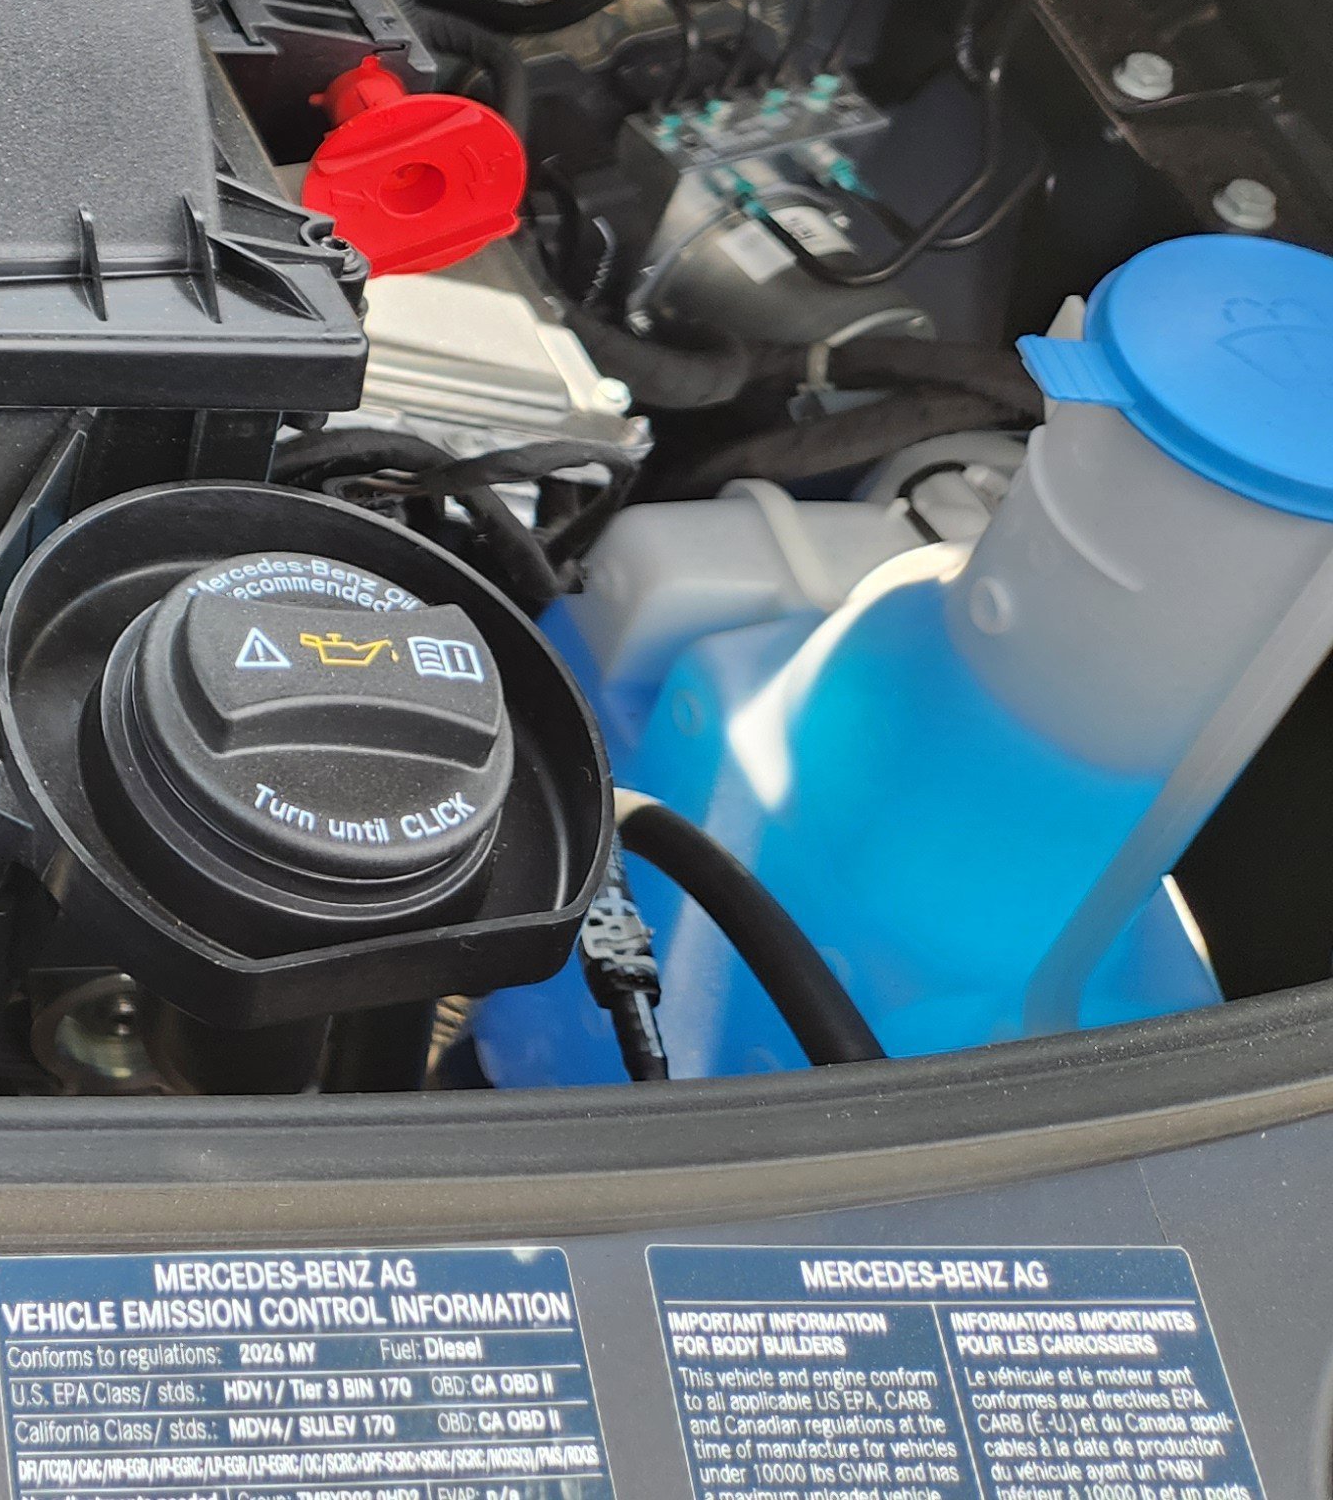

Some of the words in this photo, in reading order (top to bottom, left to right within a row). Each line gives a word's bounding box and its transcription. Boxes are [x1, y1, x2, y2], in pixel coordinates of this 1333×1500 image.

[186, 558, 378, 596] Mercedes-Benz
[384, 587, 421, 611] Oil
[225, 576, 394, 612] ecommended
[255, 783, 316, 832] Turn
[328, 816, 390, 845] until
[399, 791, 478, 841] CLICK
[153, 1258, 374, 1292] MERCEDES-BENZ
[376, 1257, 417, 1287] AG
[798, 1260, 1009, 1288] MERCEDES-BENZ
[1007, 1260, 1050, 1288] AG
[1, 1301, 117, 1333] VEHICLE
[121, 1297, 253, 1330] EMISSION
[257, 1294, 387, 1327] CONTROL
[389, 1290, 571, 1323] INFORMATION
[666, 1312, 768, 1331] IMPORTANT
[767, 1312, 888, 1331] INFORMATION
[948, 1312, 1078, 1331] INFORMATIONS
[1077, 1312, 1198, 1331] IMPORTANTES
[6, 1345, 93, 1370] Conforms
[96, 1345, 115, 1367] to
[118, 1342, 223, 1371] regulations:
[238, 1340, 285, 1364] 2026
[287, 1339, 317, 1362] MY
[379, 1337, 421, 1360] Fuel:
[423, 1335, 483, 1358] Diesel
[671, 1336, 710, 1355] FOR
[710, 1336, 762, 1355] BODY
[760, 1336, 848, 1355] BUILDERS
[955, 1335, 1006, 1355] POUR
[1005, 1335, 1040, 1355] LES
[1039, 1335, 1159, 1355] CARROSSIERS
[677, 1367, 714, 1386] This
[715, 1367, 774, 1386] vehicle
[775, 1367, 810, 1386] and
[809, 1367, 868, 1390] engine
[867, 1367, 938, 1386] conform
[963, 1366, 987, 1386] Le
[986, 1366, 1056, 1386] véhicule
[1055, 1366, 1077, 1386] et
[1076, 1366, 1095, 1386] le
[1094, 1366, 1156, 1386] moteur
[1155, 1366, 1195, 1386] sont
[10, 1383, 49, 1406] U.S.
[52, 1382, 89, 1405] EPA
[92, 1380, 153, 1410] Class/
[157, 1380, 207, 1403] stds.:
[222, 1379, 287, 1407] HDV1/
[288, 1377, 324, 1399] Tier
[326, 1376, 339, 1398] 3
[341, 1375, 374, 1398] BIN
[379, 1374, 412, 1396] 170
[430, 1373, 471, 1395] OBD:
[469, 1372, 498, 1394] CA
[498, 1371, 539, 1393] OBD
[541, 1370, 554, 1392] II
[969, 1389, 1058, 1409] conformes
[1057, 1389, 1090, 1409] aux
[1089, 1389, 1172, 1409] directives
[1170, 1389, 1208, 1409] EPA
[682, 1391, 703, 1410] to
[704, 1391, 726, 1410] all
[727, 1391, 814, 1414] applicable
[813, 1391, 841, 1410] US
[841, 1391, 883, 1413] EPA,
[882, 1391, 933, 1410] CARB
[14, 1419, 100, 1444] California
[103, 1417, 164, 1447] Class/
[168, 1418, 218, 1441] stds.:
[228, 1415, 296, 1444] MDV4/
[298, 1414, 358, 1437] SULEV
[362, 1412, 396, 1435] 170
[436, 1410, 477, 1433] OBD:
[476, 1409, 505, 1431] CA
[505, 1408, 546, 1430] OBD
[548, 1408, 561, 1429] II
[688, 1416, 721, 1434] and
[722, 1416, 802, 1434] Canadian
[803, 1416, 897, 1439] regulations
[896, 1416, 917, 1434] at
[917, 1416, 947, 1434] the
[975, 1413, 1025, 1432] CARB
[1077, 1413, 1099, 1432] et
[1098, 1413, 1124, 1432] du
[1123, 1413, 1189, 1432] Canada
